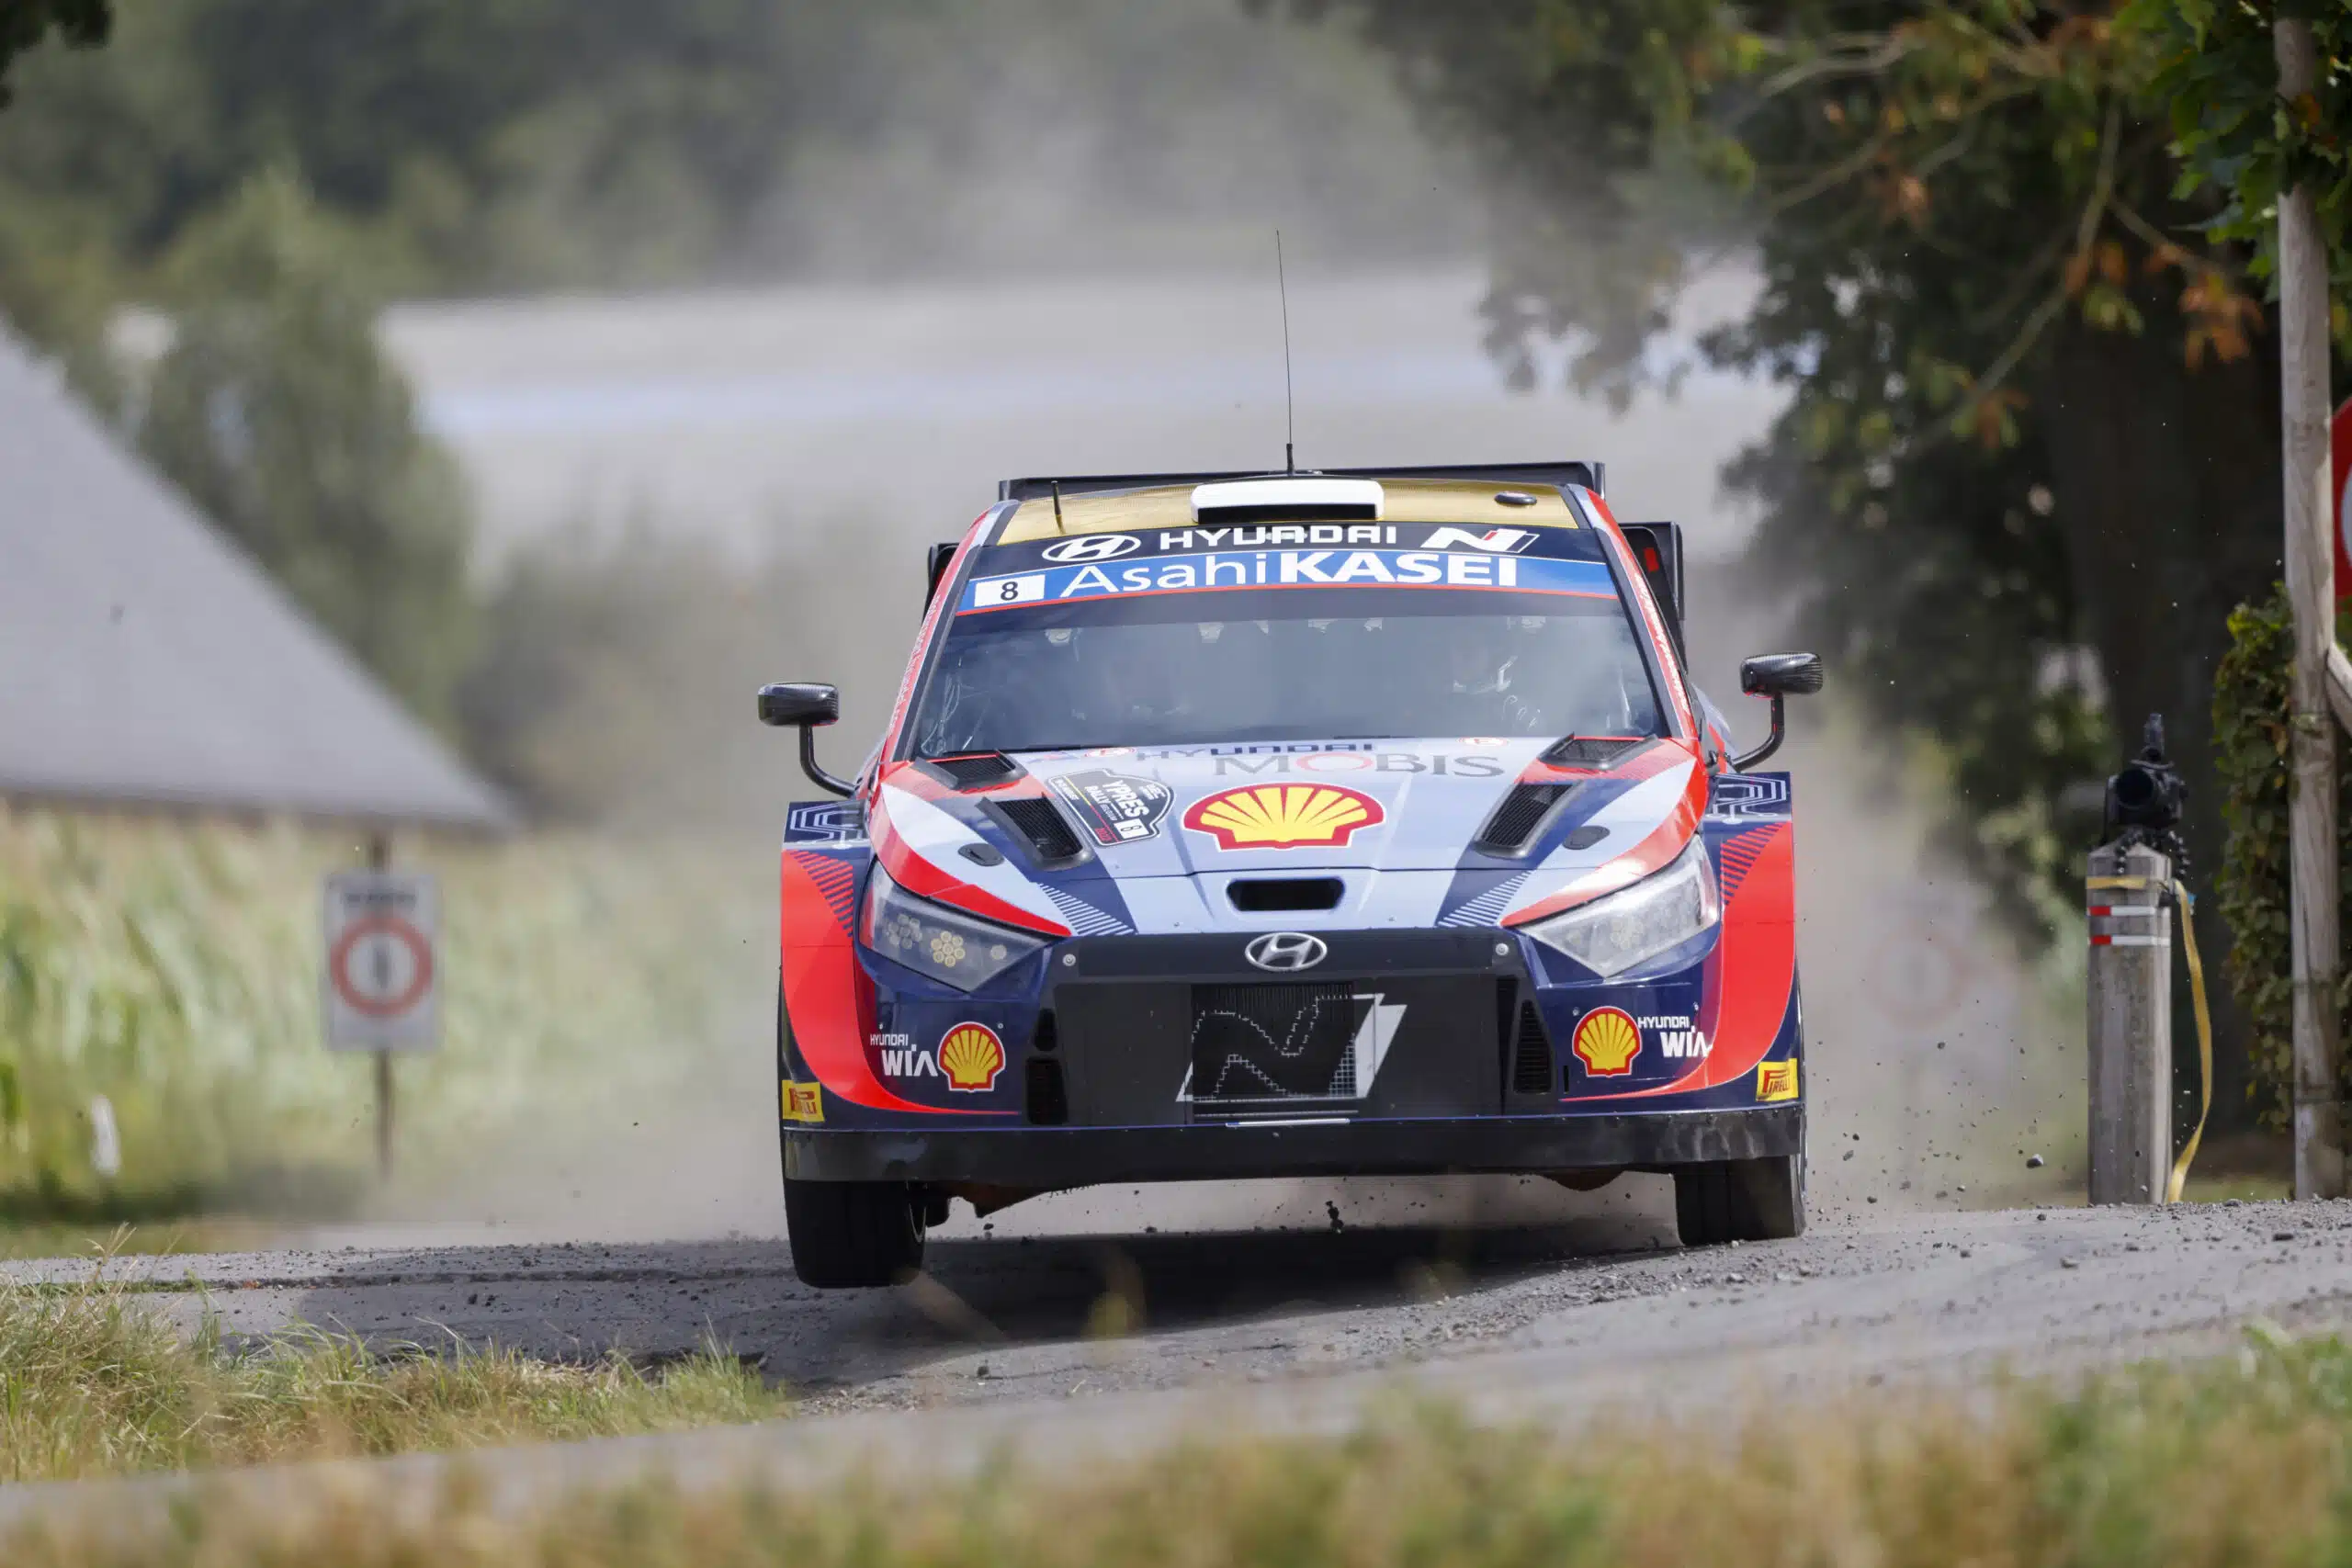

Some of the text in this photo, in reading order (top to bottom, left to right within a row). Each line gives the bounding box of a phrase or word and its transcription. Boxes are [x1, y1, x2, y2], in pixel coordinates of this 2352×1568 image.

[1159, 525, 1396, 550] HYUNDAI
[999, 581, 1019, 601] 8
[1215, 751, 1505, 778] MOBIS
[1102, 779, 1150, 818] YPRES
[1637, 1015, 1690, 1030] HYUNDAI
[870, 1033, 909, 1046] HYUNDAI
